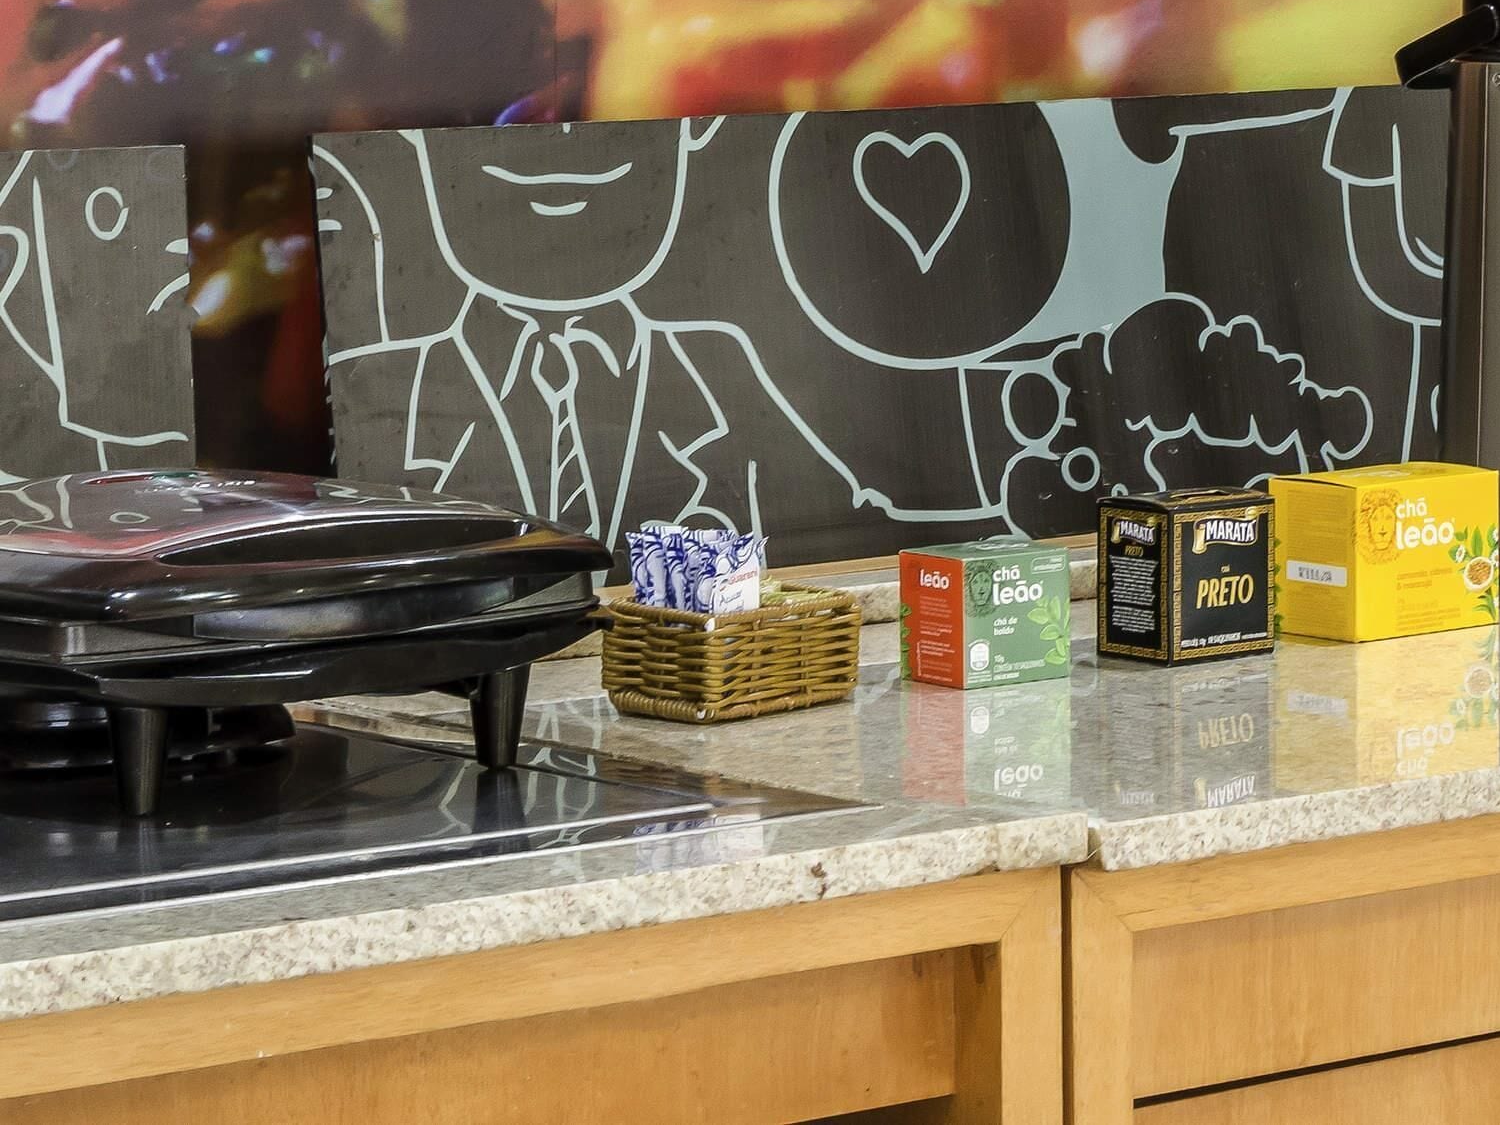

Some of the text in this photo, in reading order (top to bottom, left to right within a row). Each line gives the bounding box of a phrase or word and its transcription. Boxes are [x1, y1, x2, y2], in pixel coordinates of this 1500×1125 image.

[1396, 498, 1427, 519] chá
[1206, 520, 1257, 542] MARATÁ
[1396, 518, 1455, 550] leão
[920, 569, 949, 590] leão
[993, 565, 1020, 582] chá
[993, 580, 1043, 606] leão
[1196, 573, 1254, 610] PRETO
